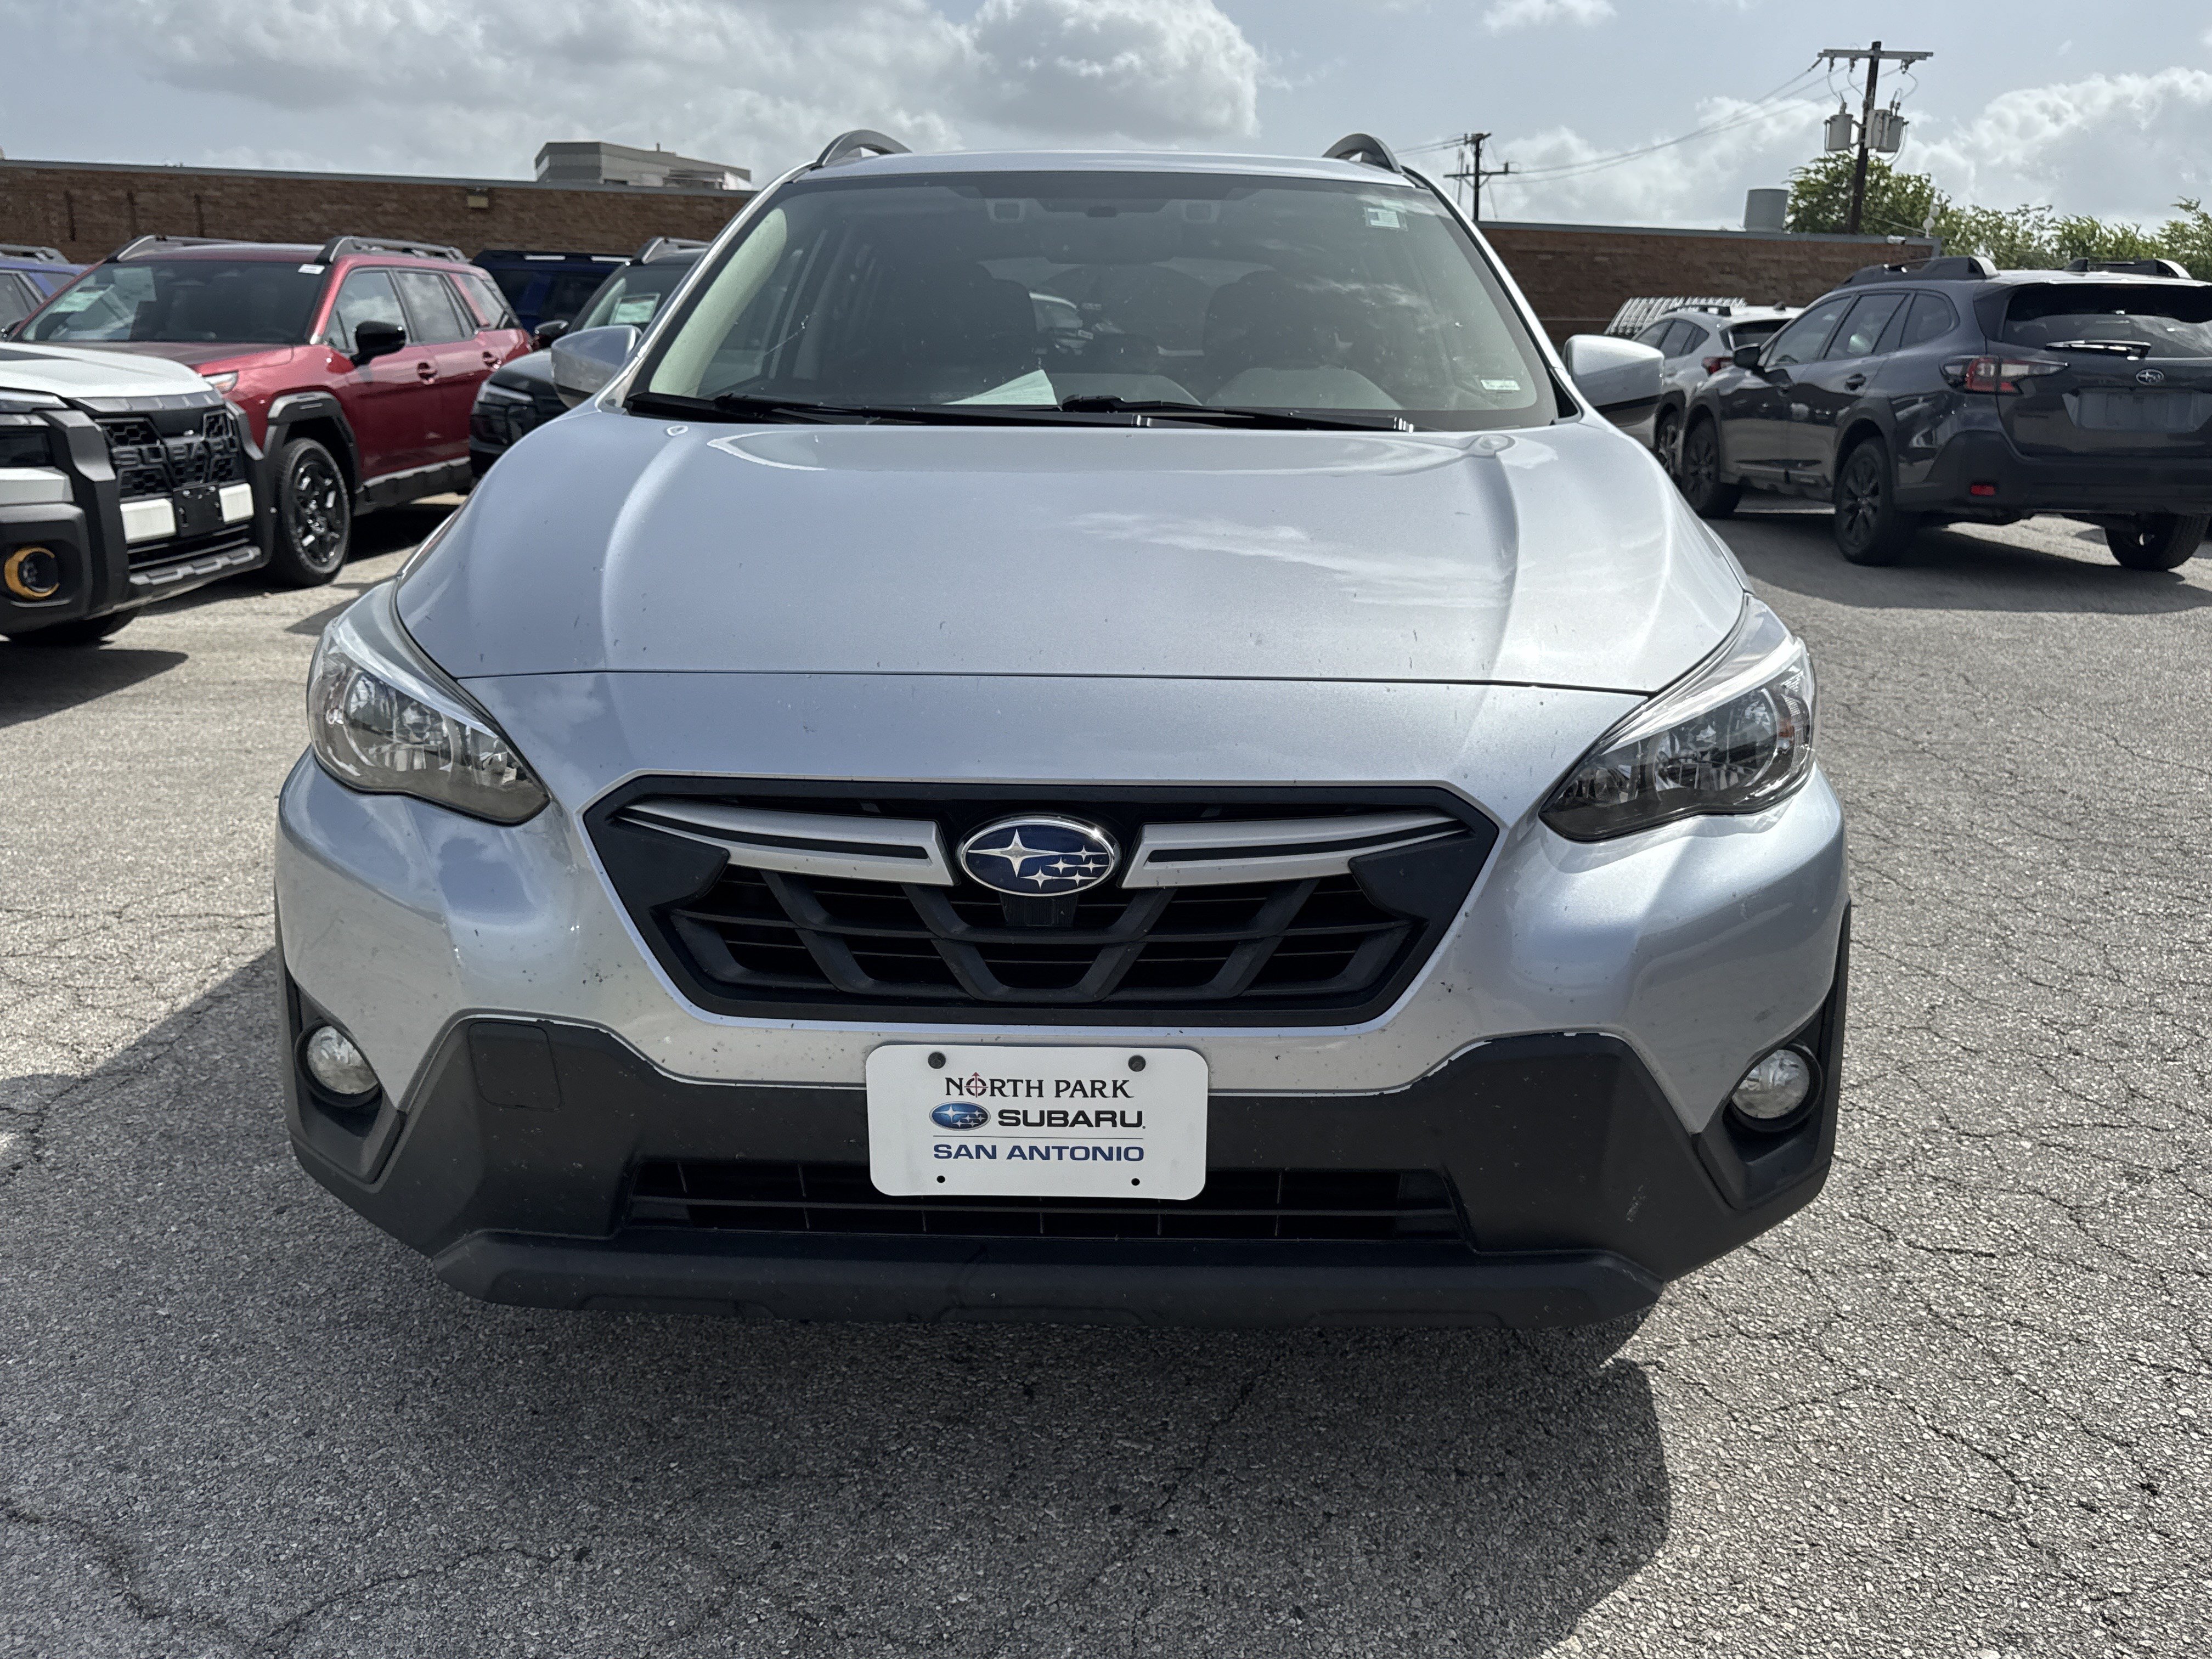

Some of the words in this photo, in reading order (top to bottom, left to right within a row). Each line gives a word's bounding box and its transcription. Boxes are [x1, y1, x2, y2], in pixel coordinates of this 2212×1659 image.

[111, 437, 240, 466] SUBARU
[945, 1076, 1044, 1098] NORTH
[1055, 1079, 1135, 1098] PARK
[998, 1109, 1143, 1128] SUBARU
[934, 1144, 997, 1160] SAN
[1007, 1145, 1144, 1161] ANTONIO
